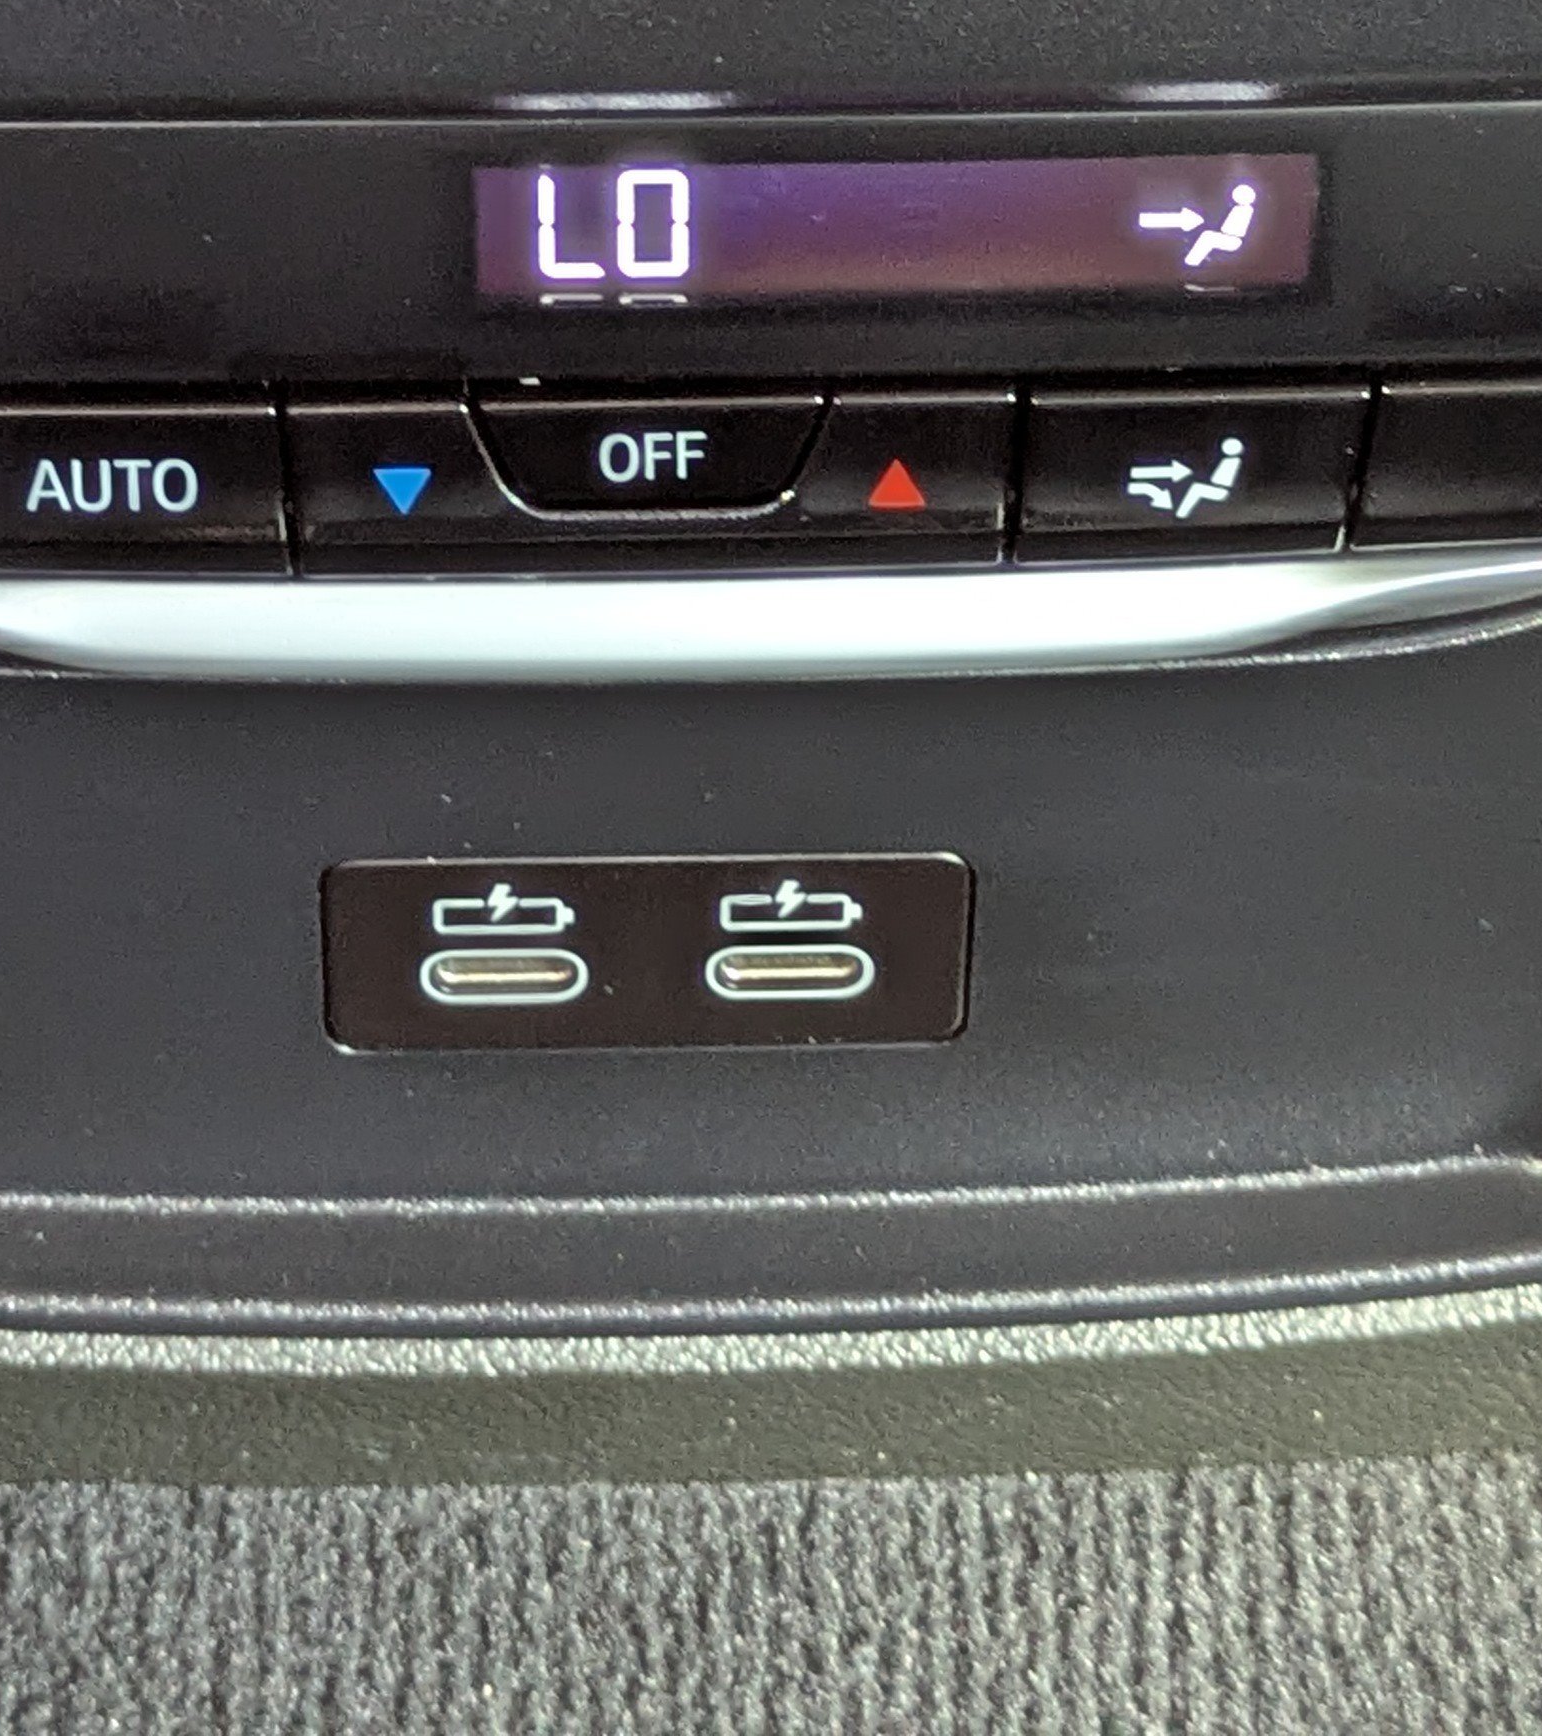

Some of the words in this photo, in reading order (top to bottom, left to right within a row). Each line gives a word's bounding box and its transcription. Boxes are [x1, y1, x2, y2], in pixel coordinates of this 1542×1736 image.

[537, 168, 690, 280] LO
[598, 430, 708, 483] OFF
[26, 458, 199, 514] AUTO
